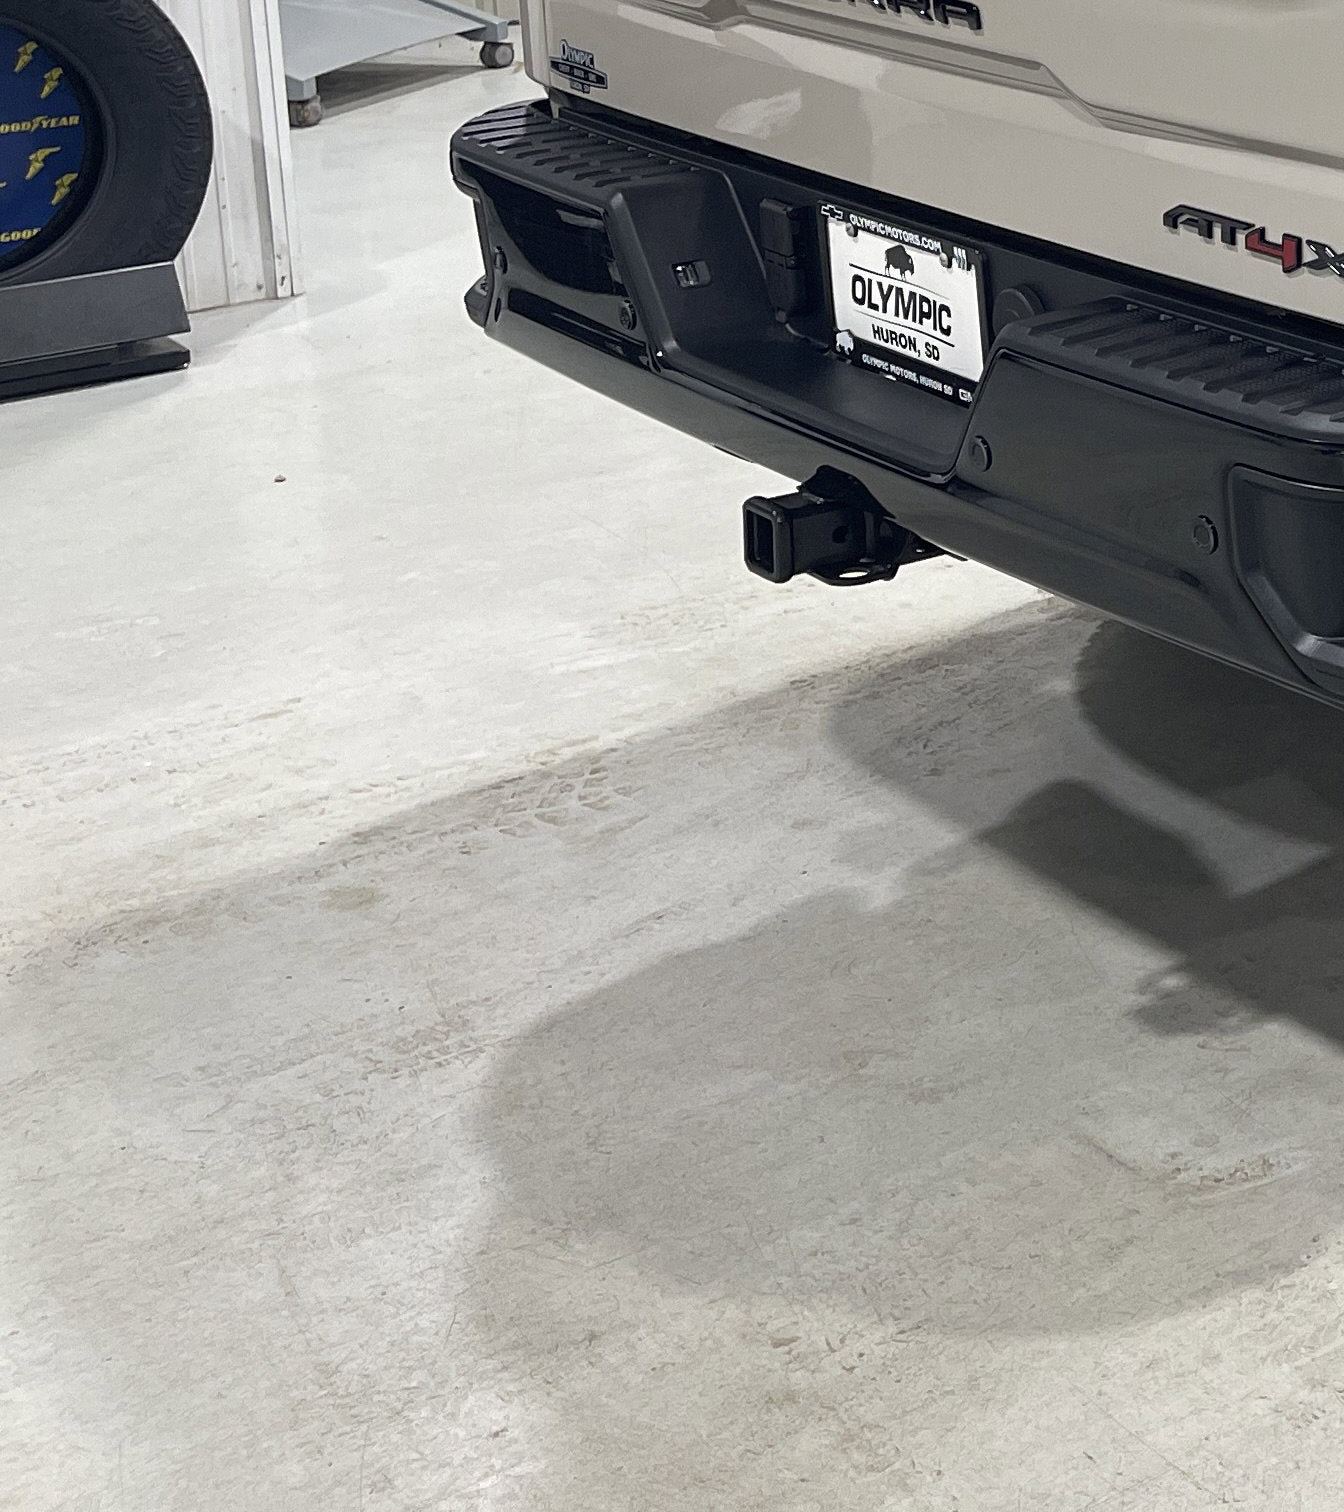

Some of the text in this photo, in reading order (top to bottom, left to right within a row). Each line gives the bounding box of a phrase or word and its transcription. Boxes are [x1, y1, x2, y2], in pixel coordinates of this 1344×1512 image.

[0, 115, 80, 134] OODYEAR
[849, 214, 942, 252] OLYMPICMOTORS.COM
[851, 274, 952, 337] OLYMPIC
[872, 324, 940, 361] HURON, SD
[862, 354, 889, 372] OLYMPIC
[919, 375, 942, 391] HURON
[944, 384, 953, 395] SD
